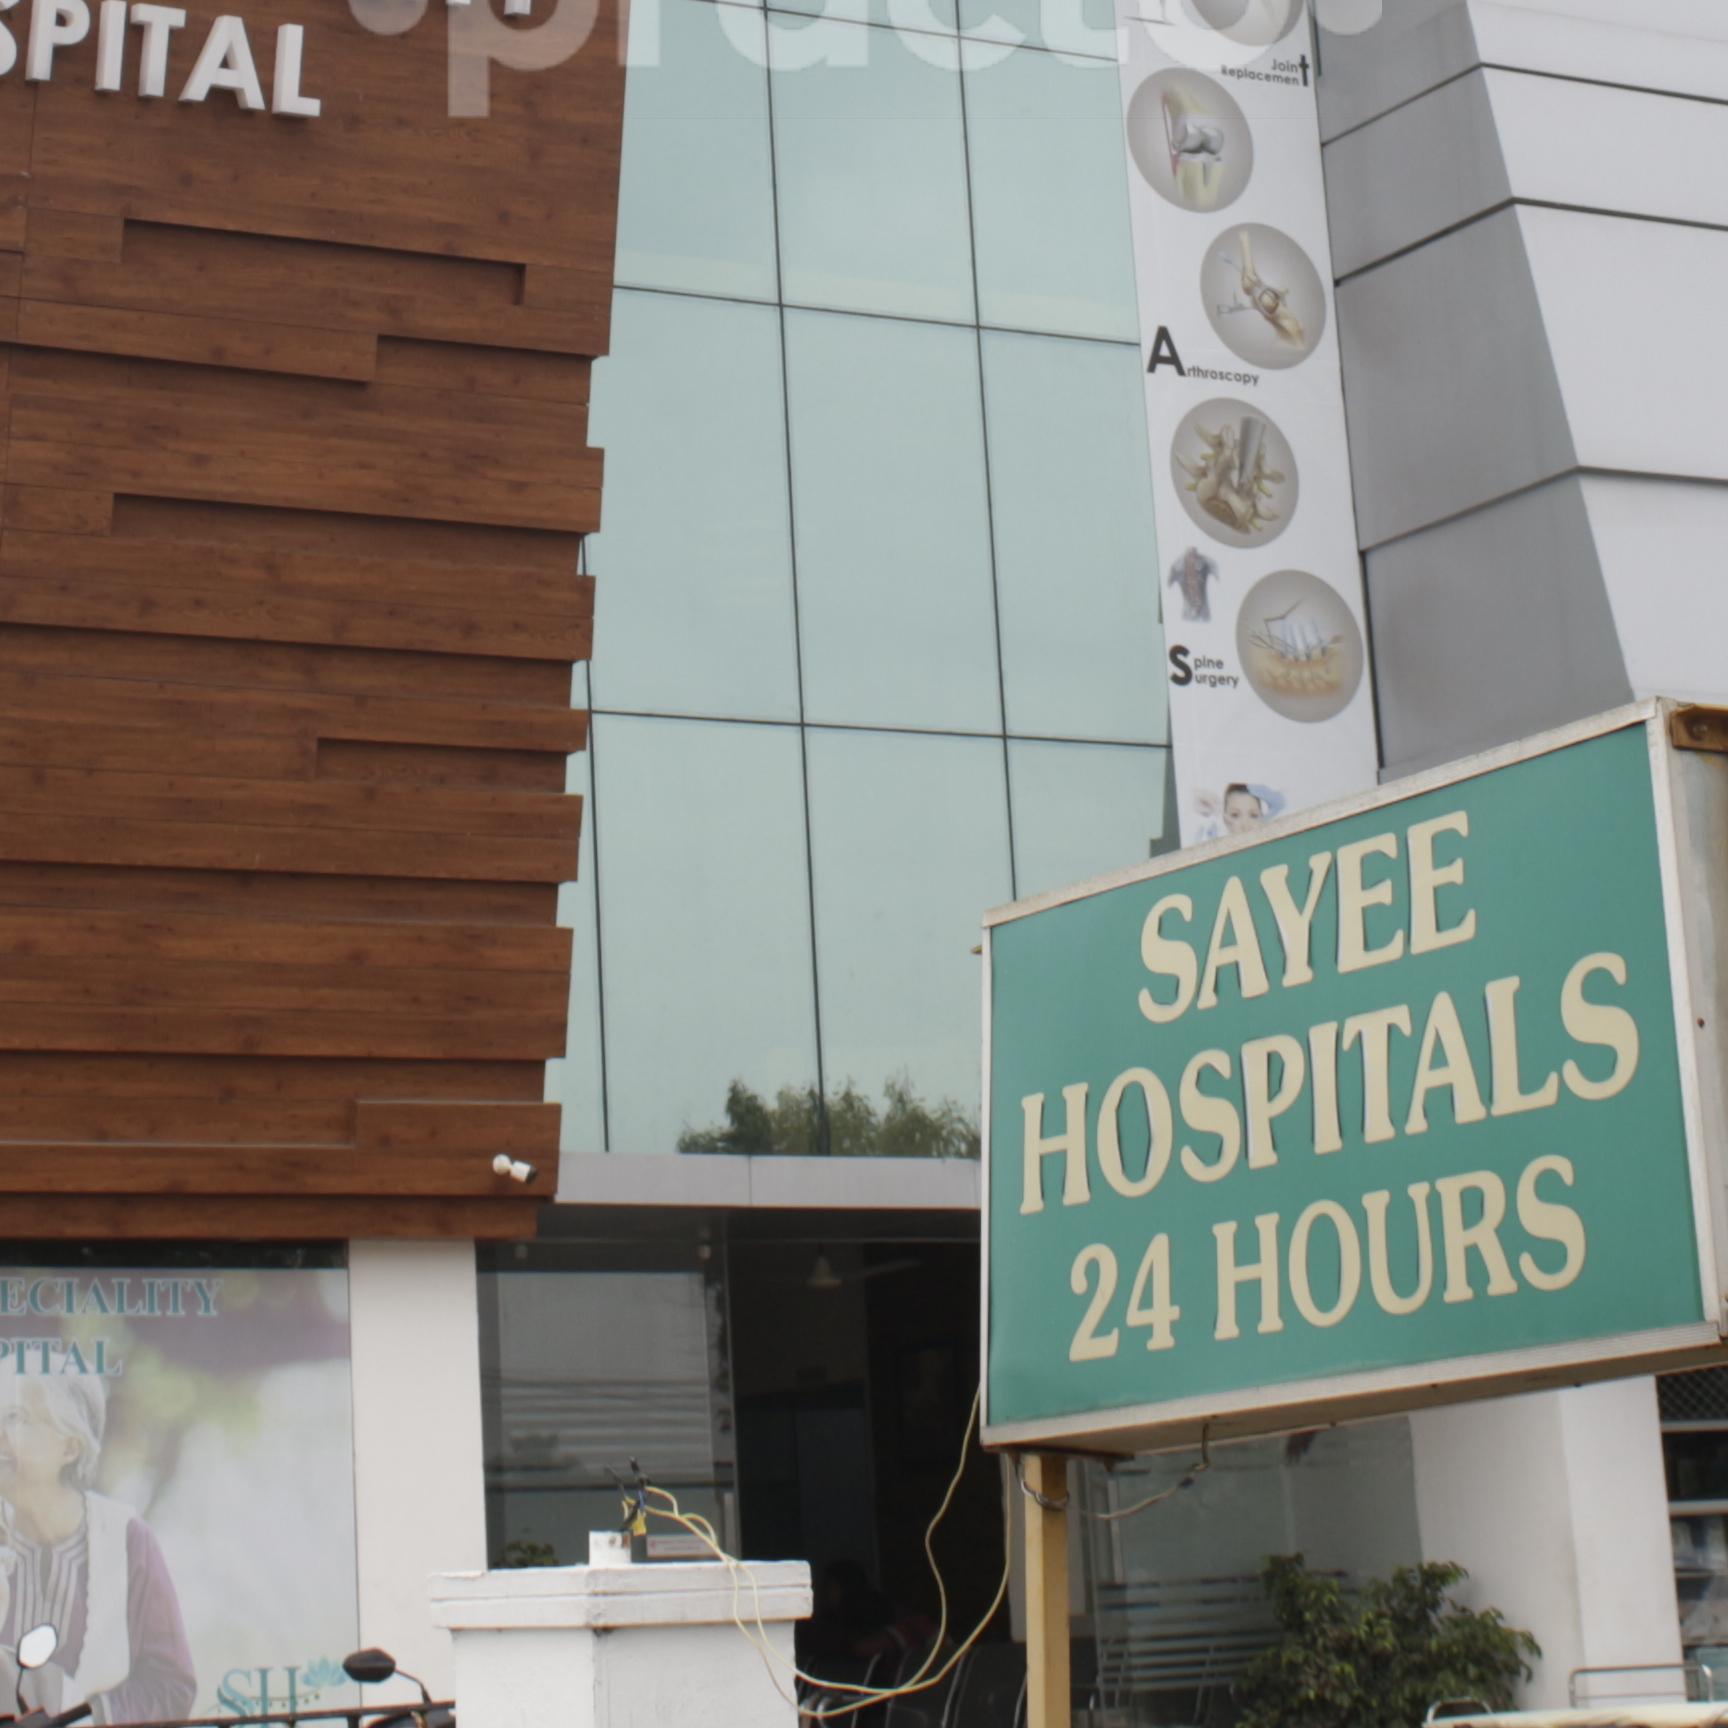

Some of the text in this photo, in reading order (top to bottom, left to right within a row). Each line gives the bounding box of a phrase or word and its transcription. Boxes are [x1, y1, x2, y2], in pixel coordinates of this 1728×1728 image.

[1147, 326, 1259, 385] Arthroscopy
[1137, 810, 1476, 1024] SAYEE
[1019, 952, 1640, 1215] HOSPITALS
[1069, 1155, 1587, 1362] 24 HOURS
